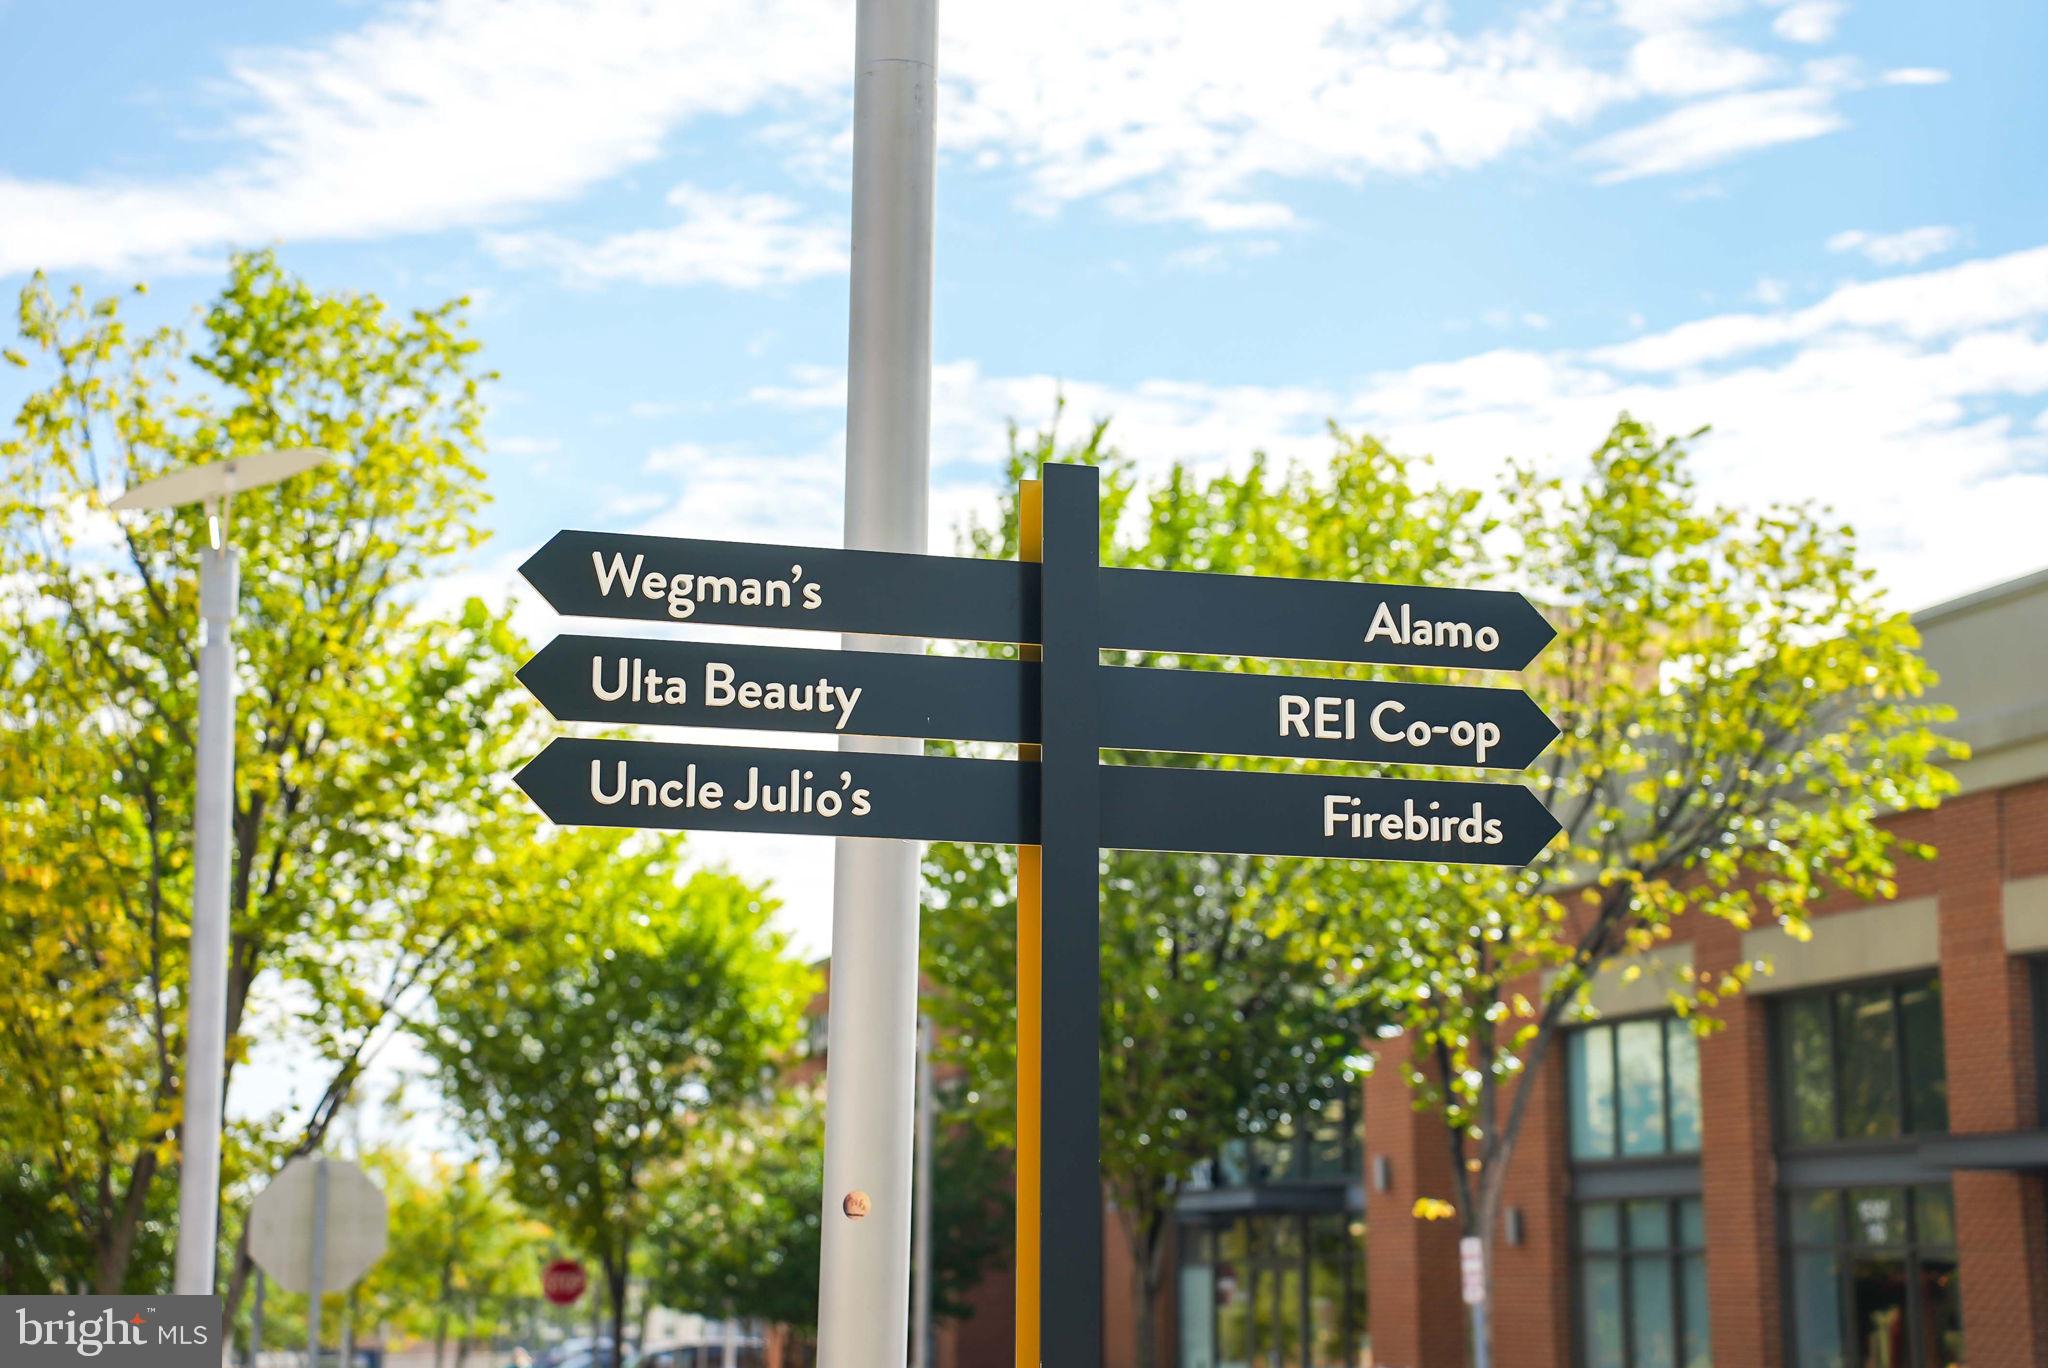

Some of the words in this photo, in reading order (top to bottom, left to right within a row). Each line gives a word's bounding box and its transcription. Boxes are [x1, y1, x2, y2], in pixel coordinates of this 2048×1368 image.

[592, 551, 823, 618] Wegman's
[1364, 602, 1500, 652] Alamo
[593, 656, 687, 704] Ulta
[705, 663, 862, 730] Beauty
[1279, 695, 1355, 739] REI
[1369, 700, 1501, 763] Co-op
[591, 760, 724, 810] Uncle
[733, 767, 871, 817] Julio's
[1323, 795, 1504, 844] Firebirds
